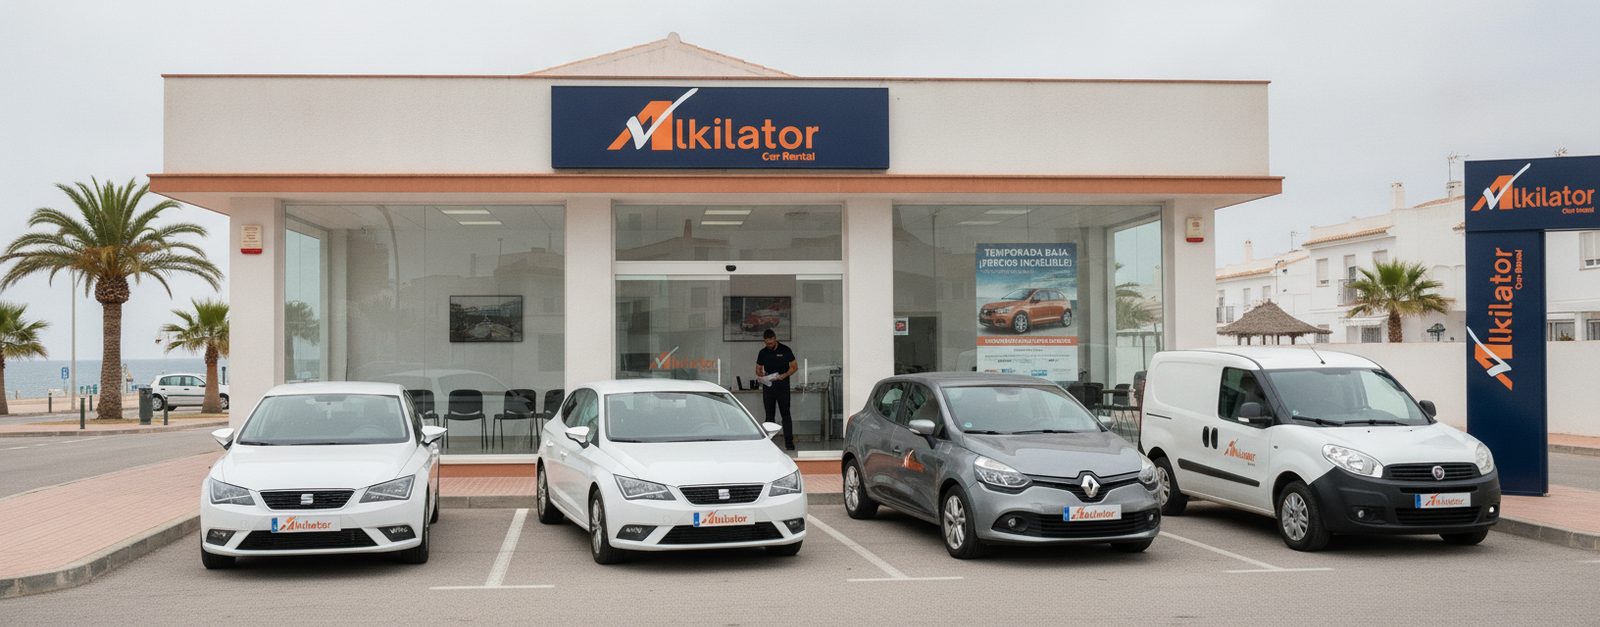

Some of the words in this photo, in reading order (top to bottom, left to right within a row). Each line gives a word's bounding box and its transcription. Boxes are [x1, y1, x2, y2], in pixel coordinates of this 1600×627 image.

[606, 100, 819, 150] Alkilator
[782, 151, 815, 161] Rental
[1471, 175, 1595, 212] Alkilator
[984, 248, 1043, 257] TEMPORADA
[1474, 247, 1513, 391] Alkilator
